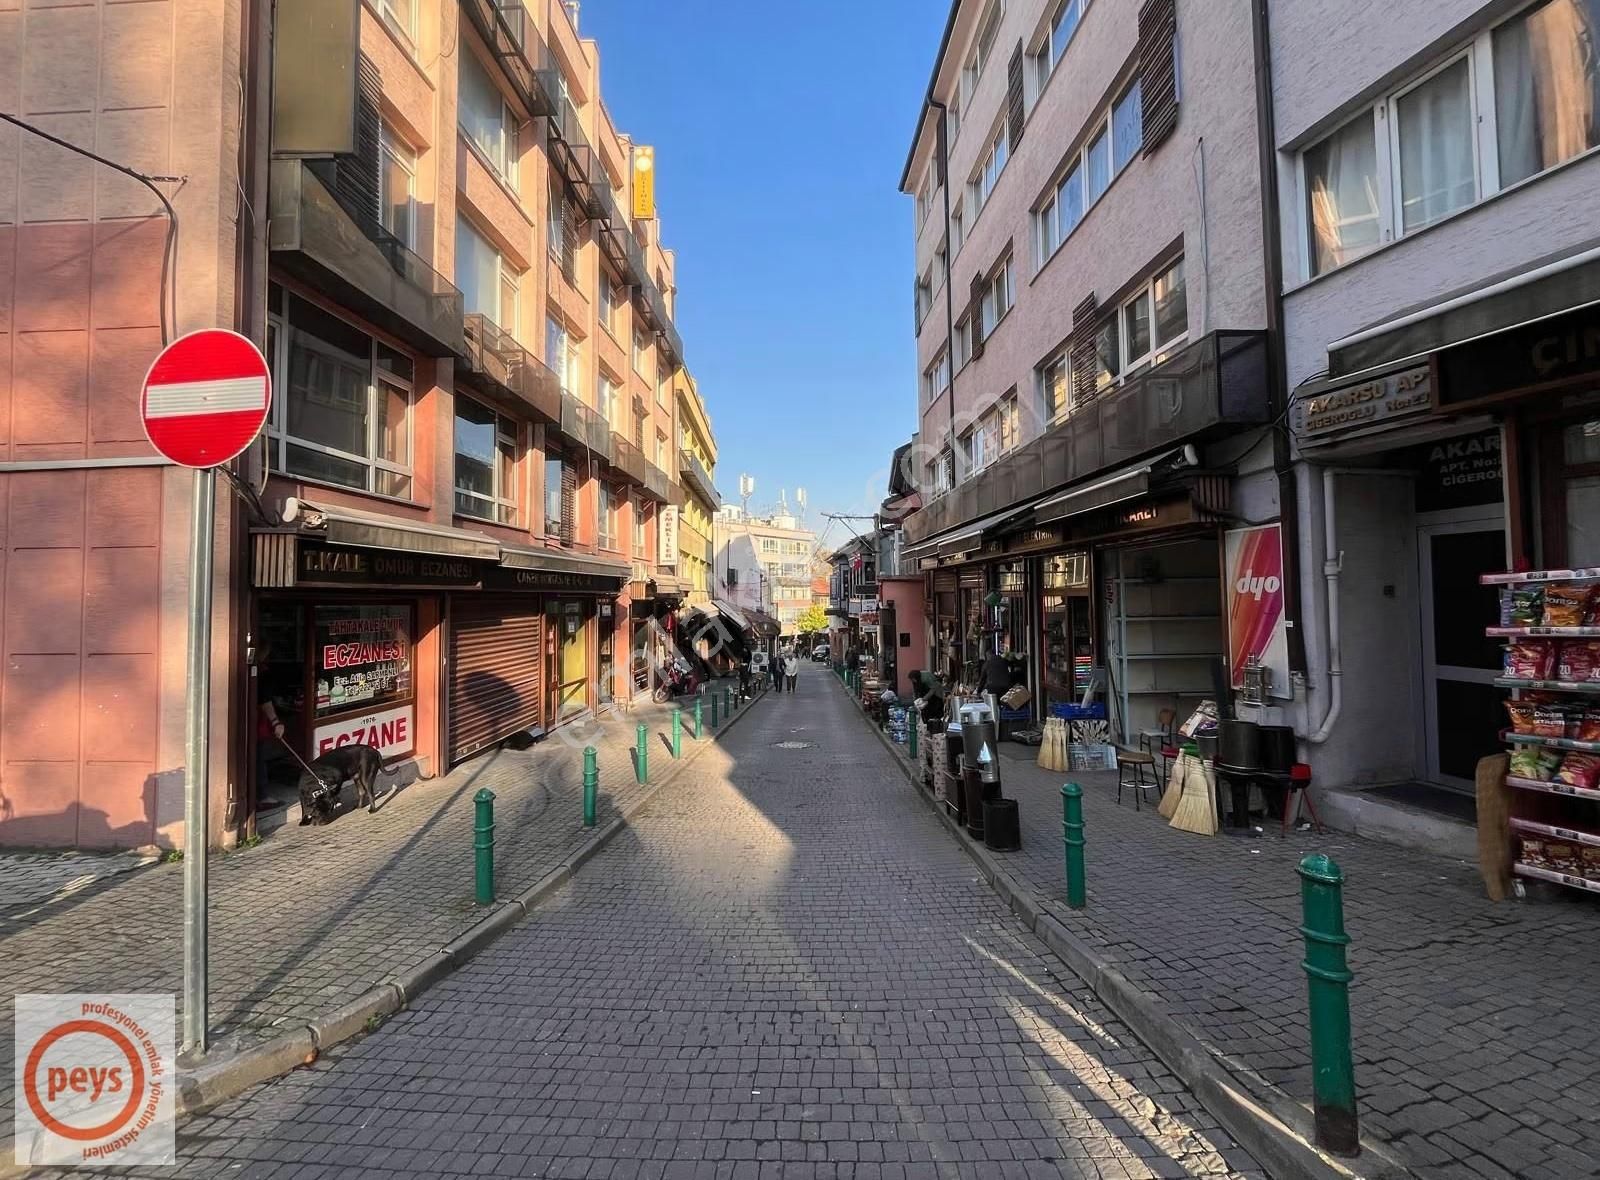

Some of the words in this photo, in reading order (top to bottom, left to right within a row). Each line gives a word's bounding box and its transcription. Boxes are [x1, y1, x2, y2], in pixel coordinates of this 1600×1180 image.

[1307, 381, 1386, 416] AKARSU
[1235, 568, 1280, 601] dyo
[324, 641, 406, 669] ECZANESİ
[319, 717, 407, 757] ECZANE
